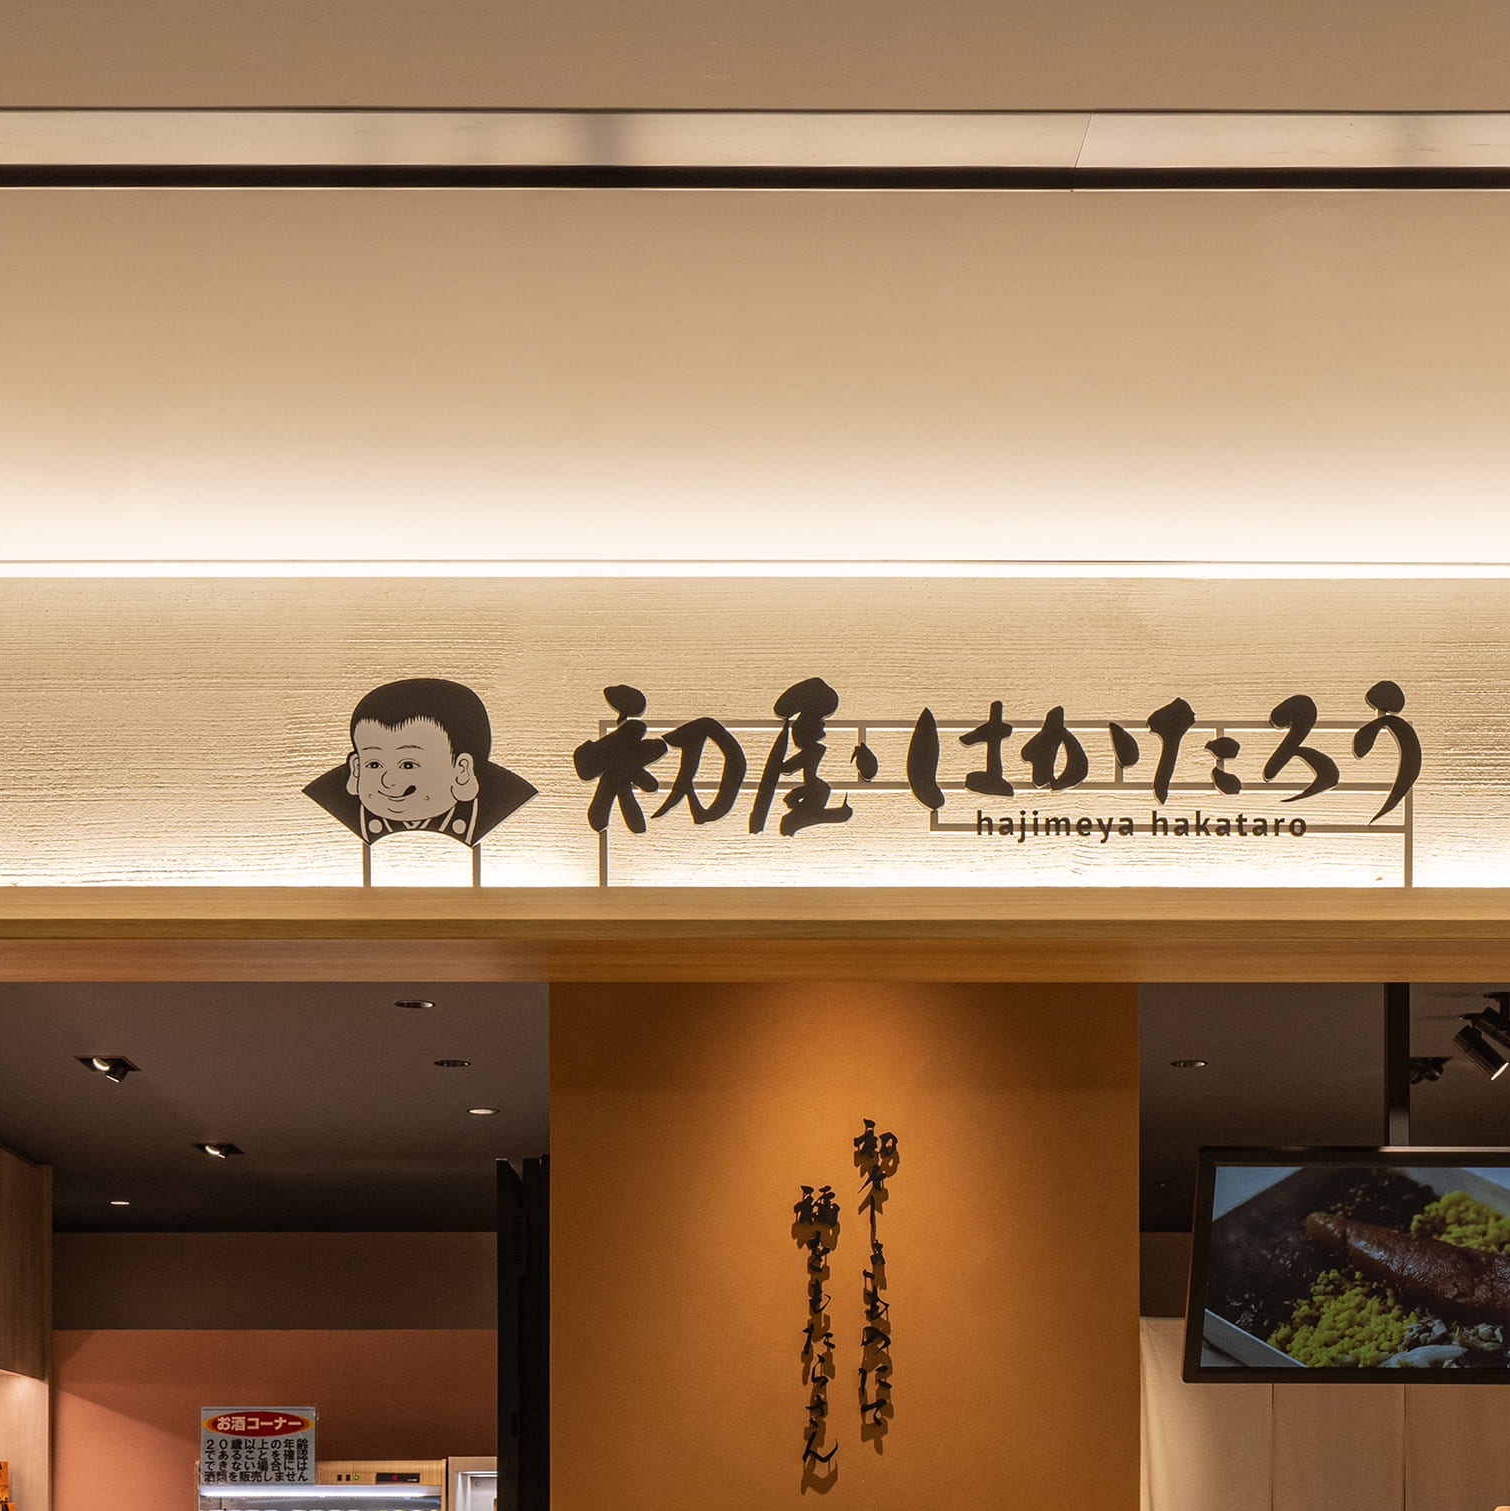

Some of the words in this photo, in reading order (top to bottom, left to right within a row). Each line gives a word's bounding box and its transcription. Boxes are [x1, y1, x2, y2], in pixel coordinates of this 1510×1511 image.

[974, 810, 1135, 843] hajimeya
[1148, 810, 1308, 839] hakataro
[217, 1416, 302, 1431] お酒コーナー
[206, 1450, 308, 1460] であることを確認
[206, 1461, 308, 1471] できない場合には
[204, 1471, 308, 1482] 酒類を販売しません
